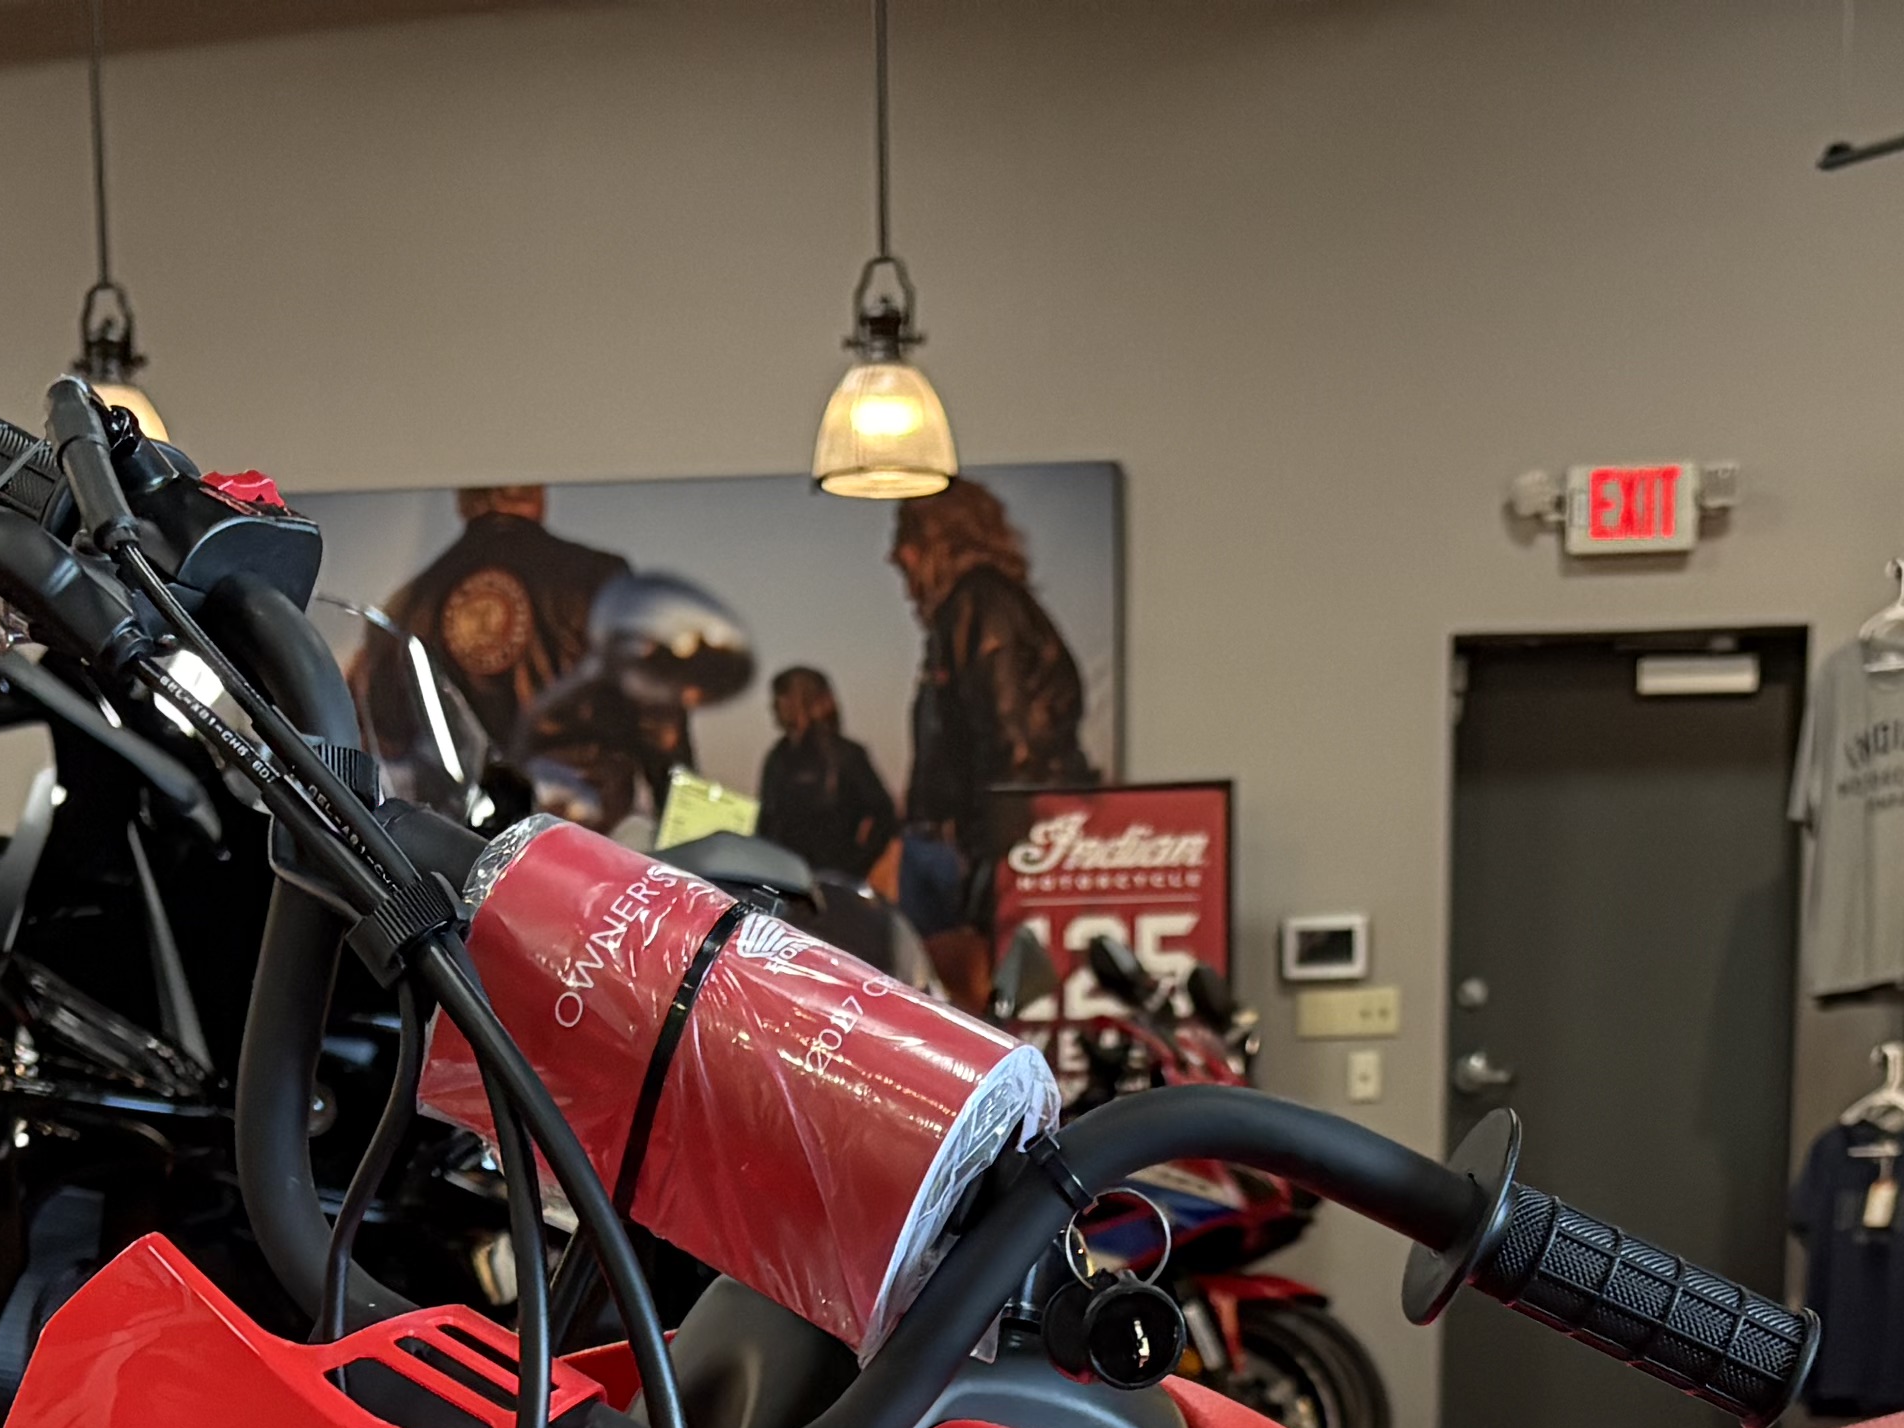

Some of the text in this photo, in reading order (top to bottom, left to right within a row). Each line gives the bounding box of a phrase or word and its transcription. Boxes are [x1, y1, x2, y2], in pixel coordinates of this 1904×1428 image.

[1589, 465, 1683, 540] EXIT
[1007, 811, 1210, 875] Indian
[555, 864, 678, 1028] OWNER'S
